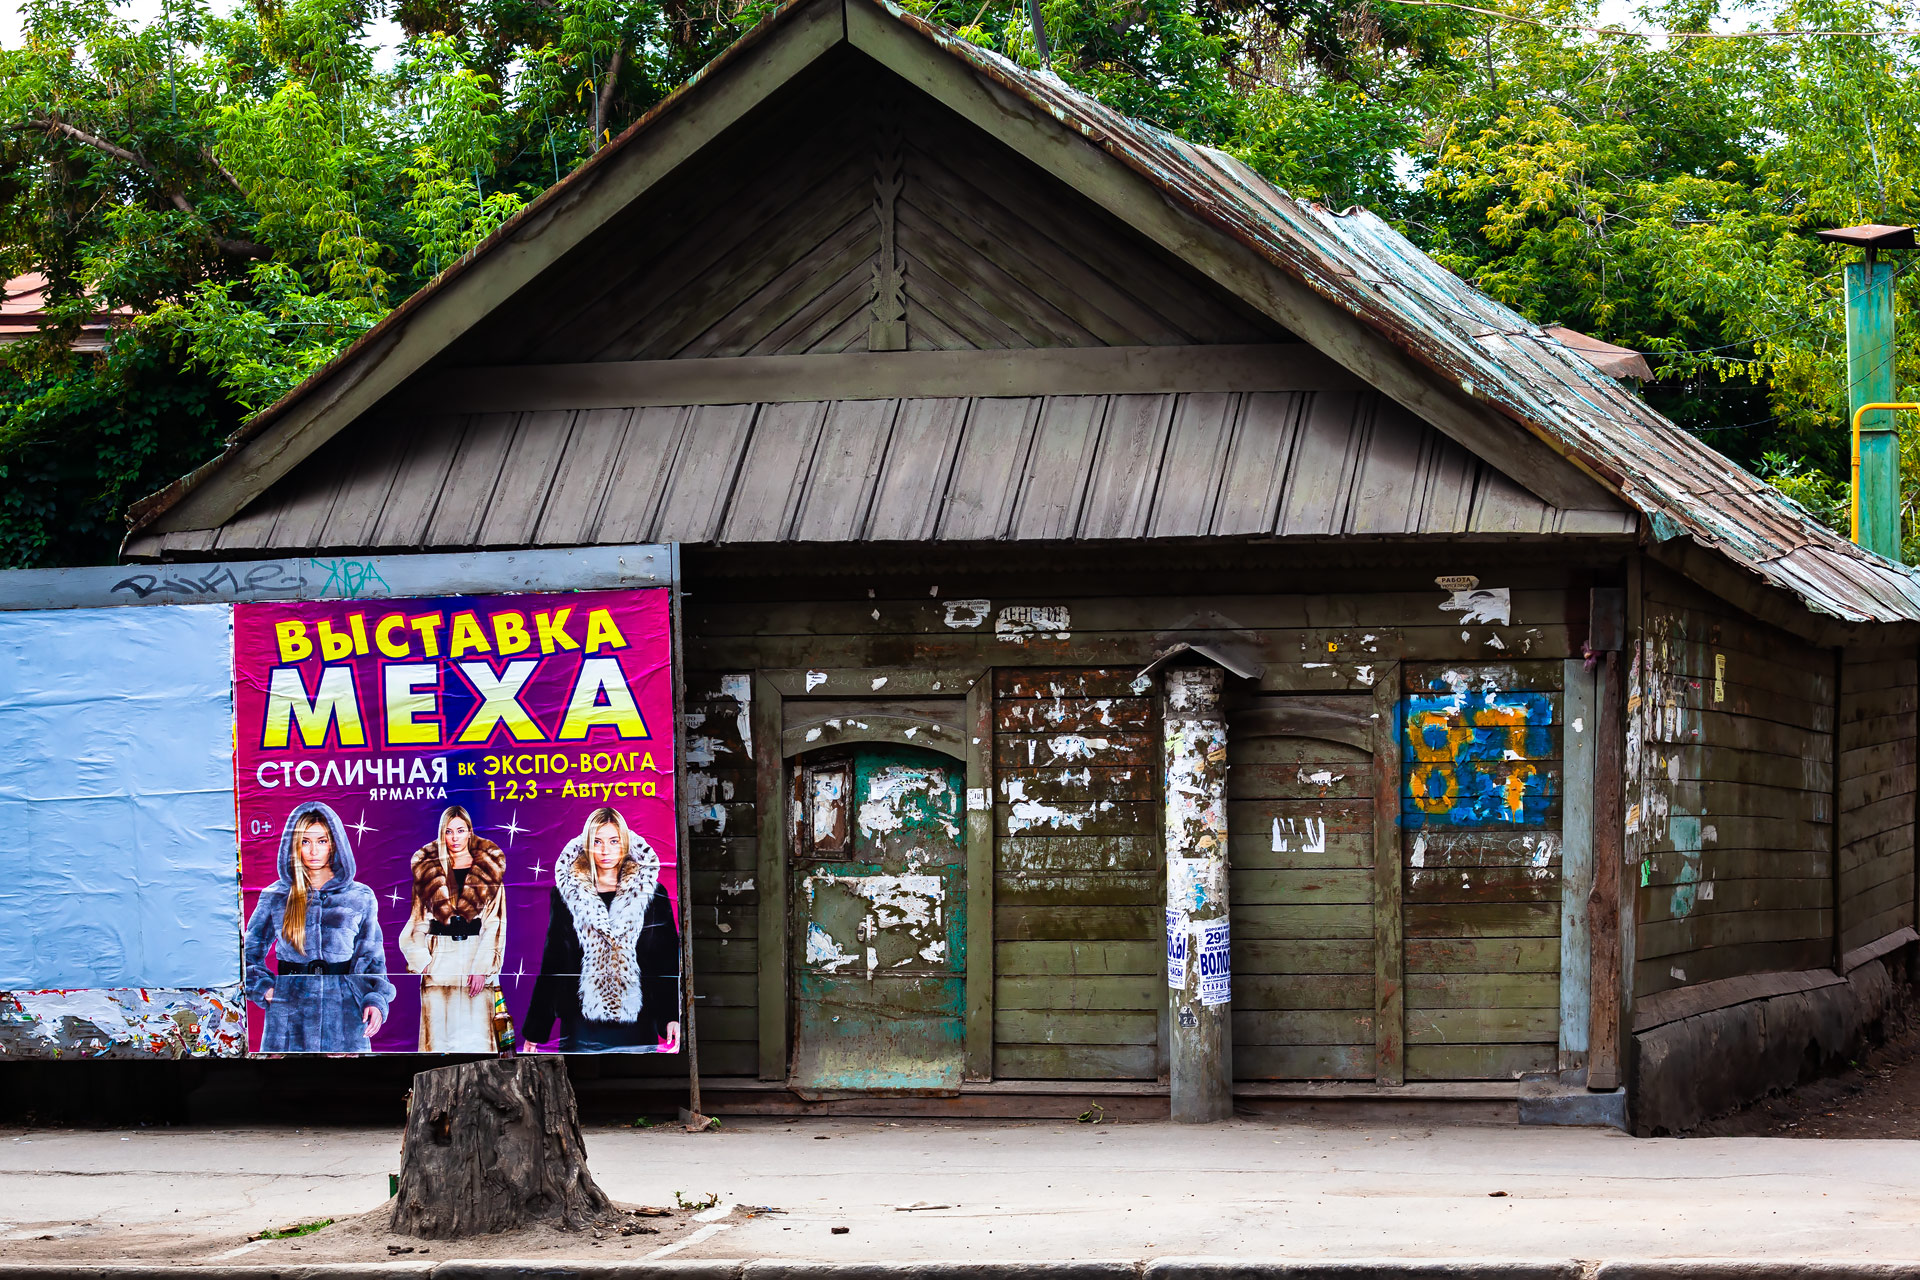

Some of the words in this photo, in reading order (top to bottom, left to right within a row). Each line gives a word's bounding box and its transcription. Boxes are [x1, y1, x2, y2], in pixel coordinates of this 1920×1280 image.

[275, 608, 627, 663] ВЫСТАВКА
[262, 657, 648, 749] МЕХА
[256, 757, 448, 788] СТОЛИЧНАЯ
[458, 762, 477, 776] ВК
[483, 752, 656, 776] ЭКСПО-ВОЛГА
[369, 786, 448, 801] ЯРМАРКА
[487, 779, 538, 802] 1,2,3
[561, 779, 656, 802] Августа
[250, 819, 272, 835] 0+
[1205, 931, 1221, 945] 29
[1202, 981, 1227, 991] СТАРЫЕ
